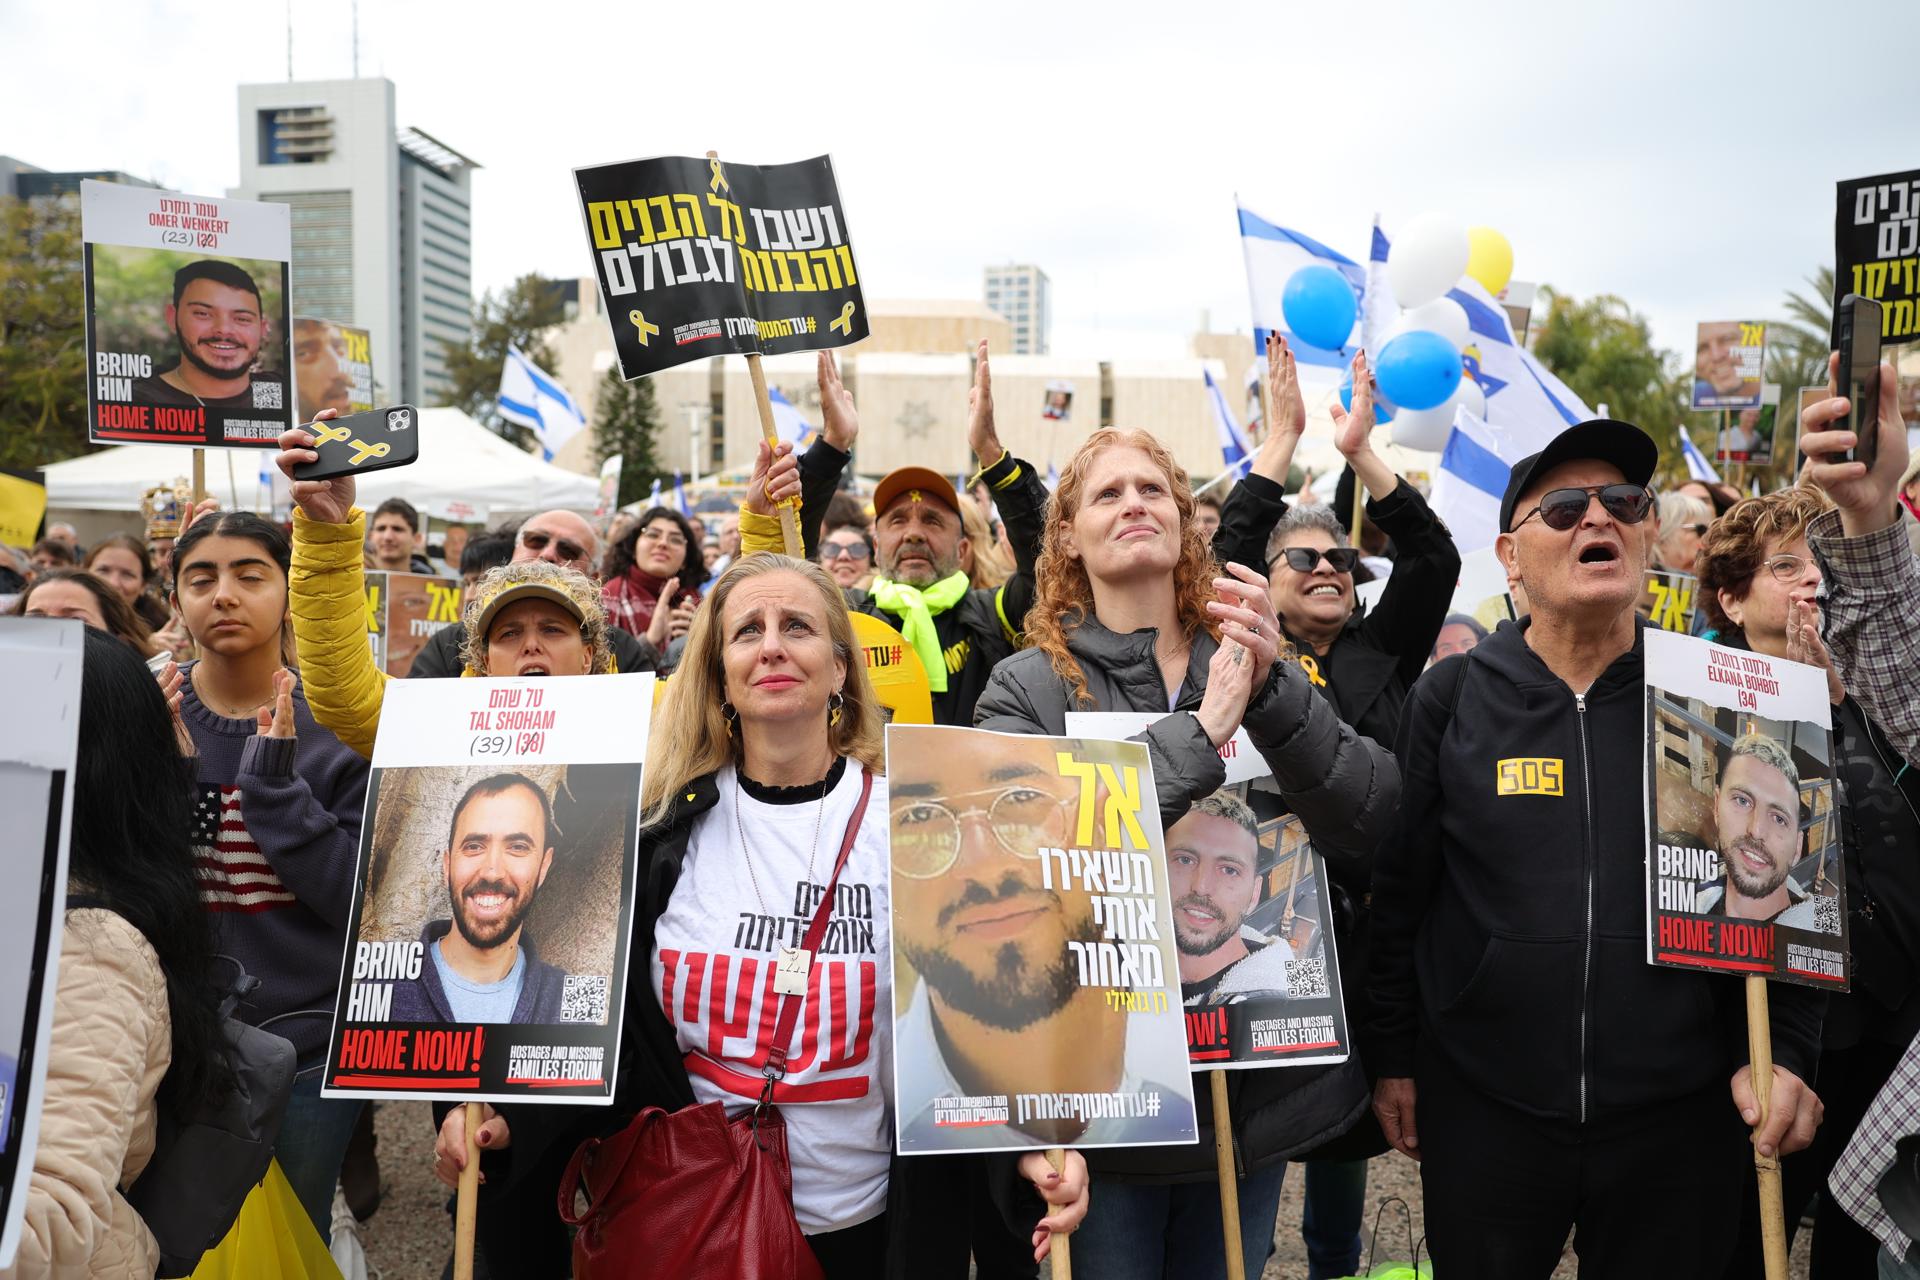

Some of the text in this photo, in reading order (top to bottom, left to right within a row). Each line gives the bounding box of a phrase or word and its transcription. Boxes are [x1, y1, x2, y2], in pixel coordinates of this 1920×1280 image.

[160, 199, 218, 218] עומר ונקרט
[588, 192, 841, 250] ושבו כל הבנים
[149, 213, 229, 234] OMER WENKERT
[162, 230, 194, 247] (23)
[1877, 218, 1920, 259] כם
[601, 235, 857, 296] והבנות לגבולם
[1852, 257, 1920, 299] זיקו
[724, 316, 816, 340] #עדהחטוףאחרון
[1738, 322, 1765, 347] אל
[342, 329, 370, 364] אל
[96, 352, 152, 378] BRING
[97, 377, 132, 402] HIM
[97, 404, 206, 433] HOME NOW!
[224, 427, 258, 438] FAMILIES
[426, 582, 460, 623] אל
[1648, 579, 1691, 632] אל
[1710, 649, 1772, 677] אלקנה בוחבוט
[1708, 665, 1780, 696] ELKANA BOHBOT
[489, 688, 544, 708] טל שהם
[1738, 689, 1757, 710] (34)
[470, 710, 556, 730] TAL SHOHAM
[470, 736, 512, 756] (39)
[1501, 761, 1560, 792] SOS
[1056, 752, 1150, 850] אל
[1038, 848, 1154, 894] תשאירו
[1658, 844, 1718, 881] BRING
[1658, 880, 1696, 914] HIM
[1090, 896, 1160, 940] אותי
[1659, 915, 1775, 961] HOME NOW!
[352, 942, 424, 980] BRING
[1068, 941, 1164, 987] מאחור
[1788, 944, 1843, 963] HOSTAGES AND MISSING
[1788, 954, 1844, 978] FAMILIES FORUM
[346, 983, 394, 1022] HIM
[1153, 991, 1168, 1016] רן
[1250, 1015, 1334, 1031] HOSTAGES AND MISSING
[1252, 1026, 1336, 1047] FAMILIES FORUM
[338, 1026, 484, 1073] HOME NOW!
[510, 1045, 604, 1060] HOSTAGES AND MISSING
[508, 1060, 602, 1080] FAMILIES FORUM
[934, 1095, 1008, 1108] מטה המשפחות להחזרת
[935, 1107, 1009, 1124] החטופים והנעדרים
[1016, 1092, 1160, 1124] #עדהחטוףהאחרון
